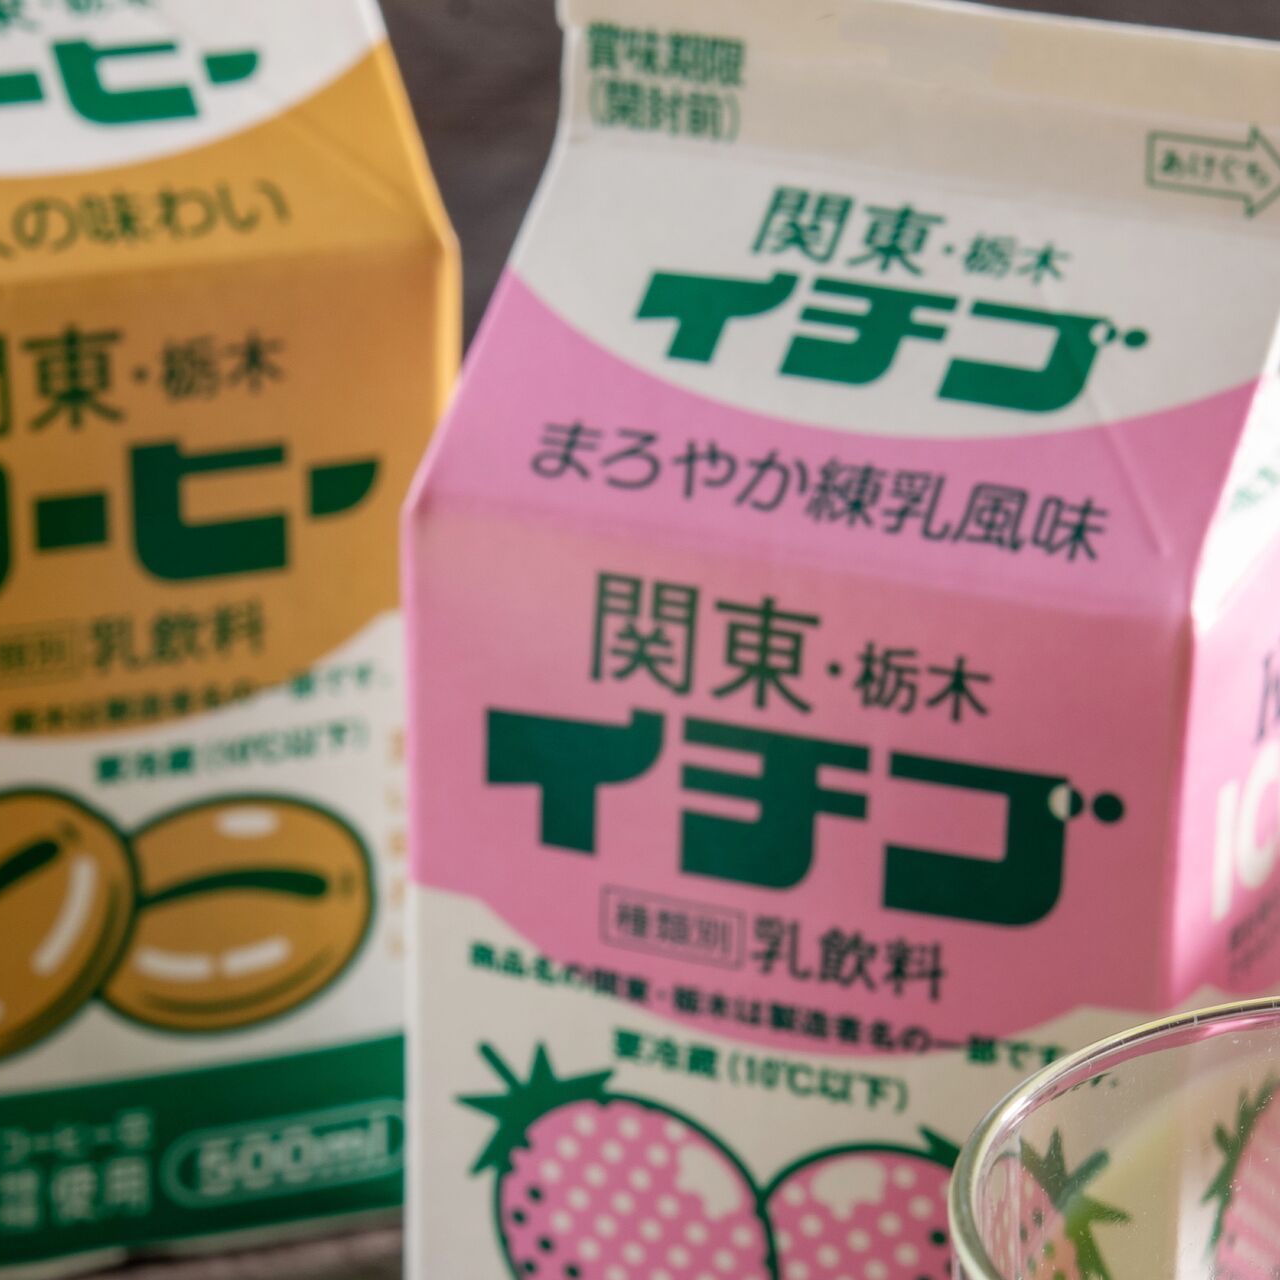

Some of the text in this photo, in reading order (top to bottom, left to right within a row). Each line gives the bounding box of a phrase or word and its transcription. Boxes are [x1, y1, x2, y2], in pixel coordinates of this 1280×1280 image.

[588, 23, 743, 86] 賞味期限
[635, 271, 1148, 412] イチゴ
[531, 420, 1109, 564] まろやか練乳風味
[589, 572, 993, 723] 関東・栃木
[486, 708, 1125, 928] イチゴ
[752, 914, 944, 1001] 乳飲料
